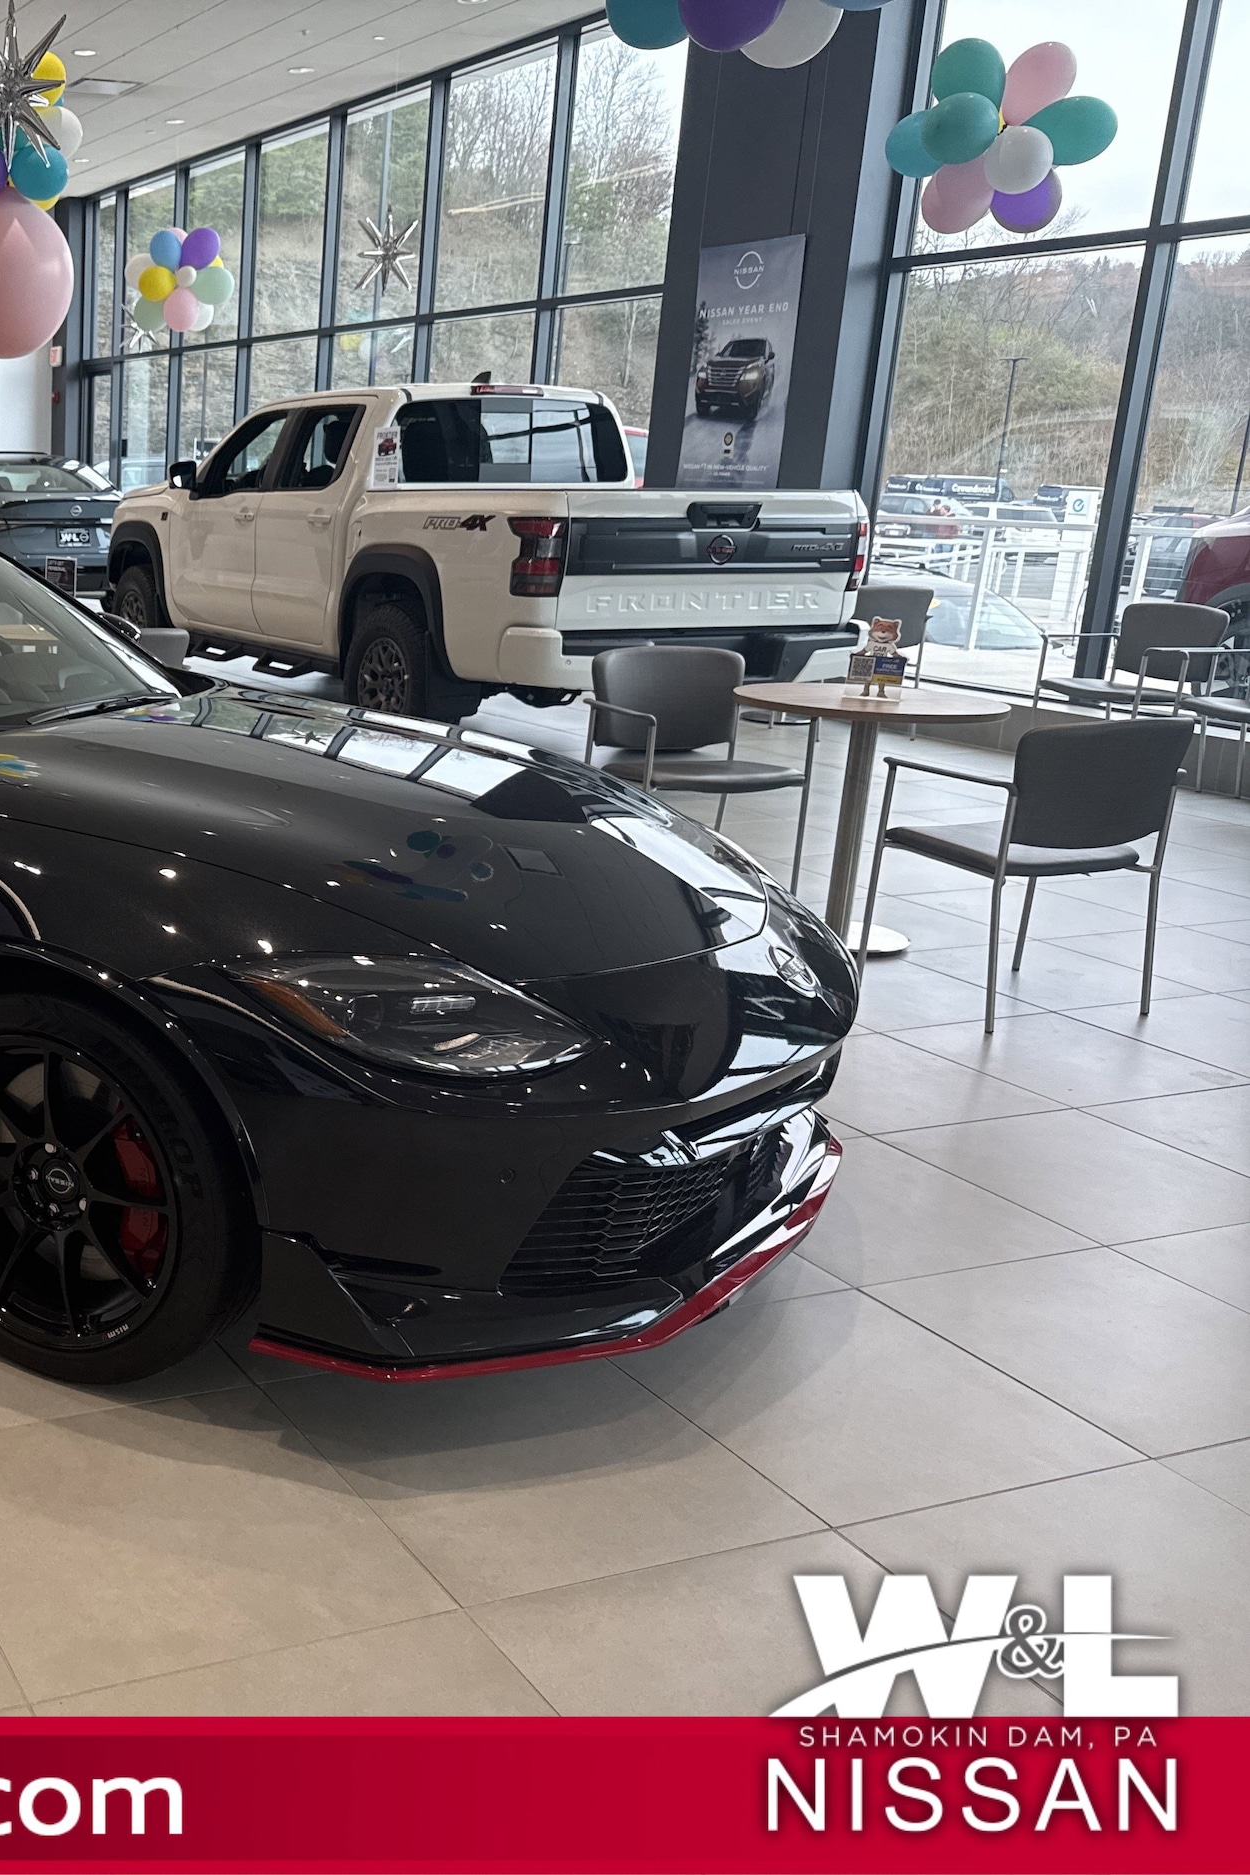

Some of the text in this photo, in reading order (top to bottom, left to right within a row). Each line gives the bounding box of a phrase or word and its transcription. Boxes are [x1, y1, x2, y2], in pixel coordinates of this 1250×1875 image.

[733, 264, 765, 275] NISSAN
[699, 301, 789, 319] NISSAN YEAR END
[742, 317, 763, 325] EVENT
[951, 483, 996, 495] Groundworks
[422, 514, 497, 532] PRO-4X
[586, 589, 820, 614] FRONTIER
[45, 1174, 75, 1188] NISSAN
